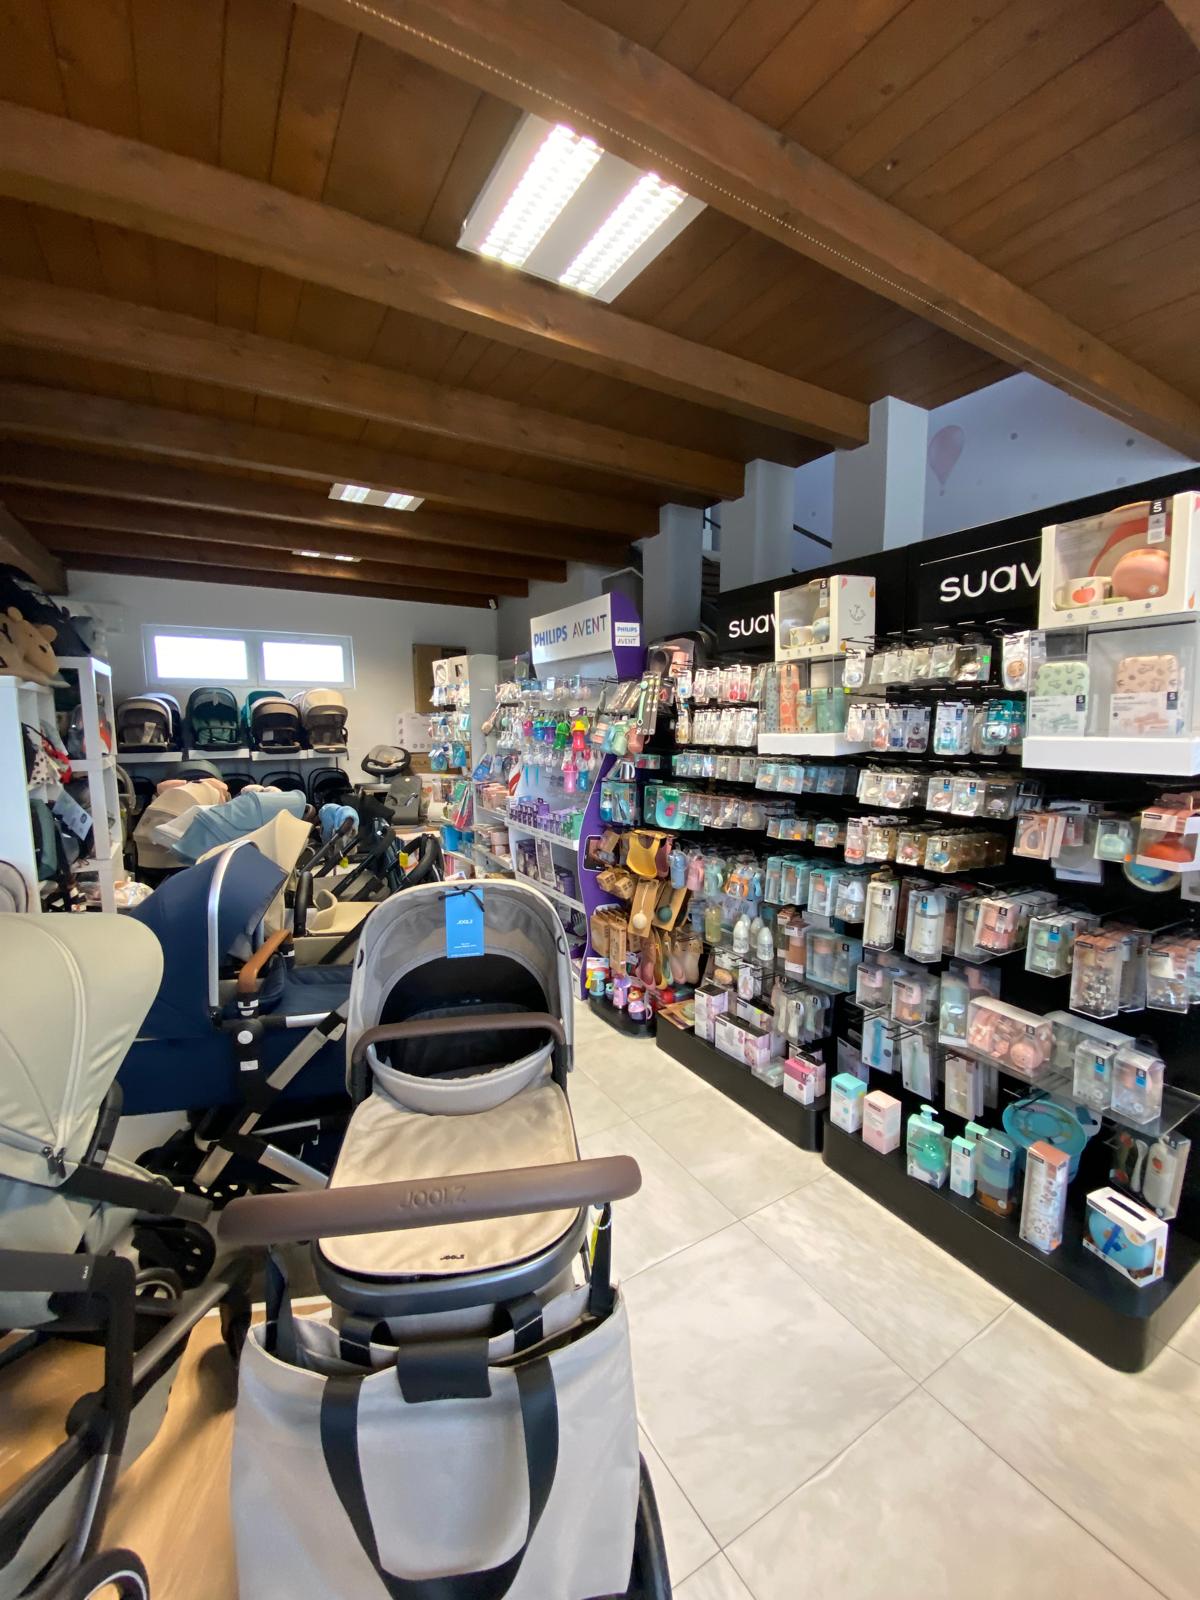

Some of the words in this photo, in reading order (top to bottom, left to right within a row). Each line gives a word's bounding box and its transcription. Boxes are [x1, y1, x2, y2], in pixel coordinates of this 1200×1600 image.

[533, 625, 567, 648] PHILIPS
[573, 614, 607, 638] AVENT
[398, 1184, 466, 1209] JOOLZ
